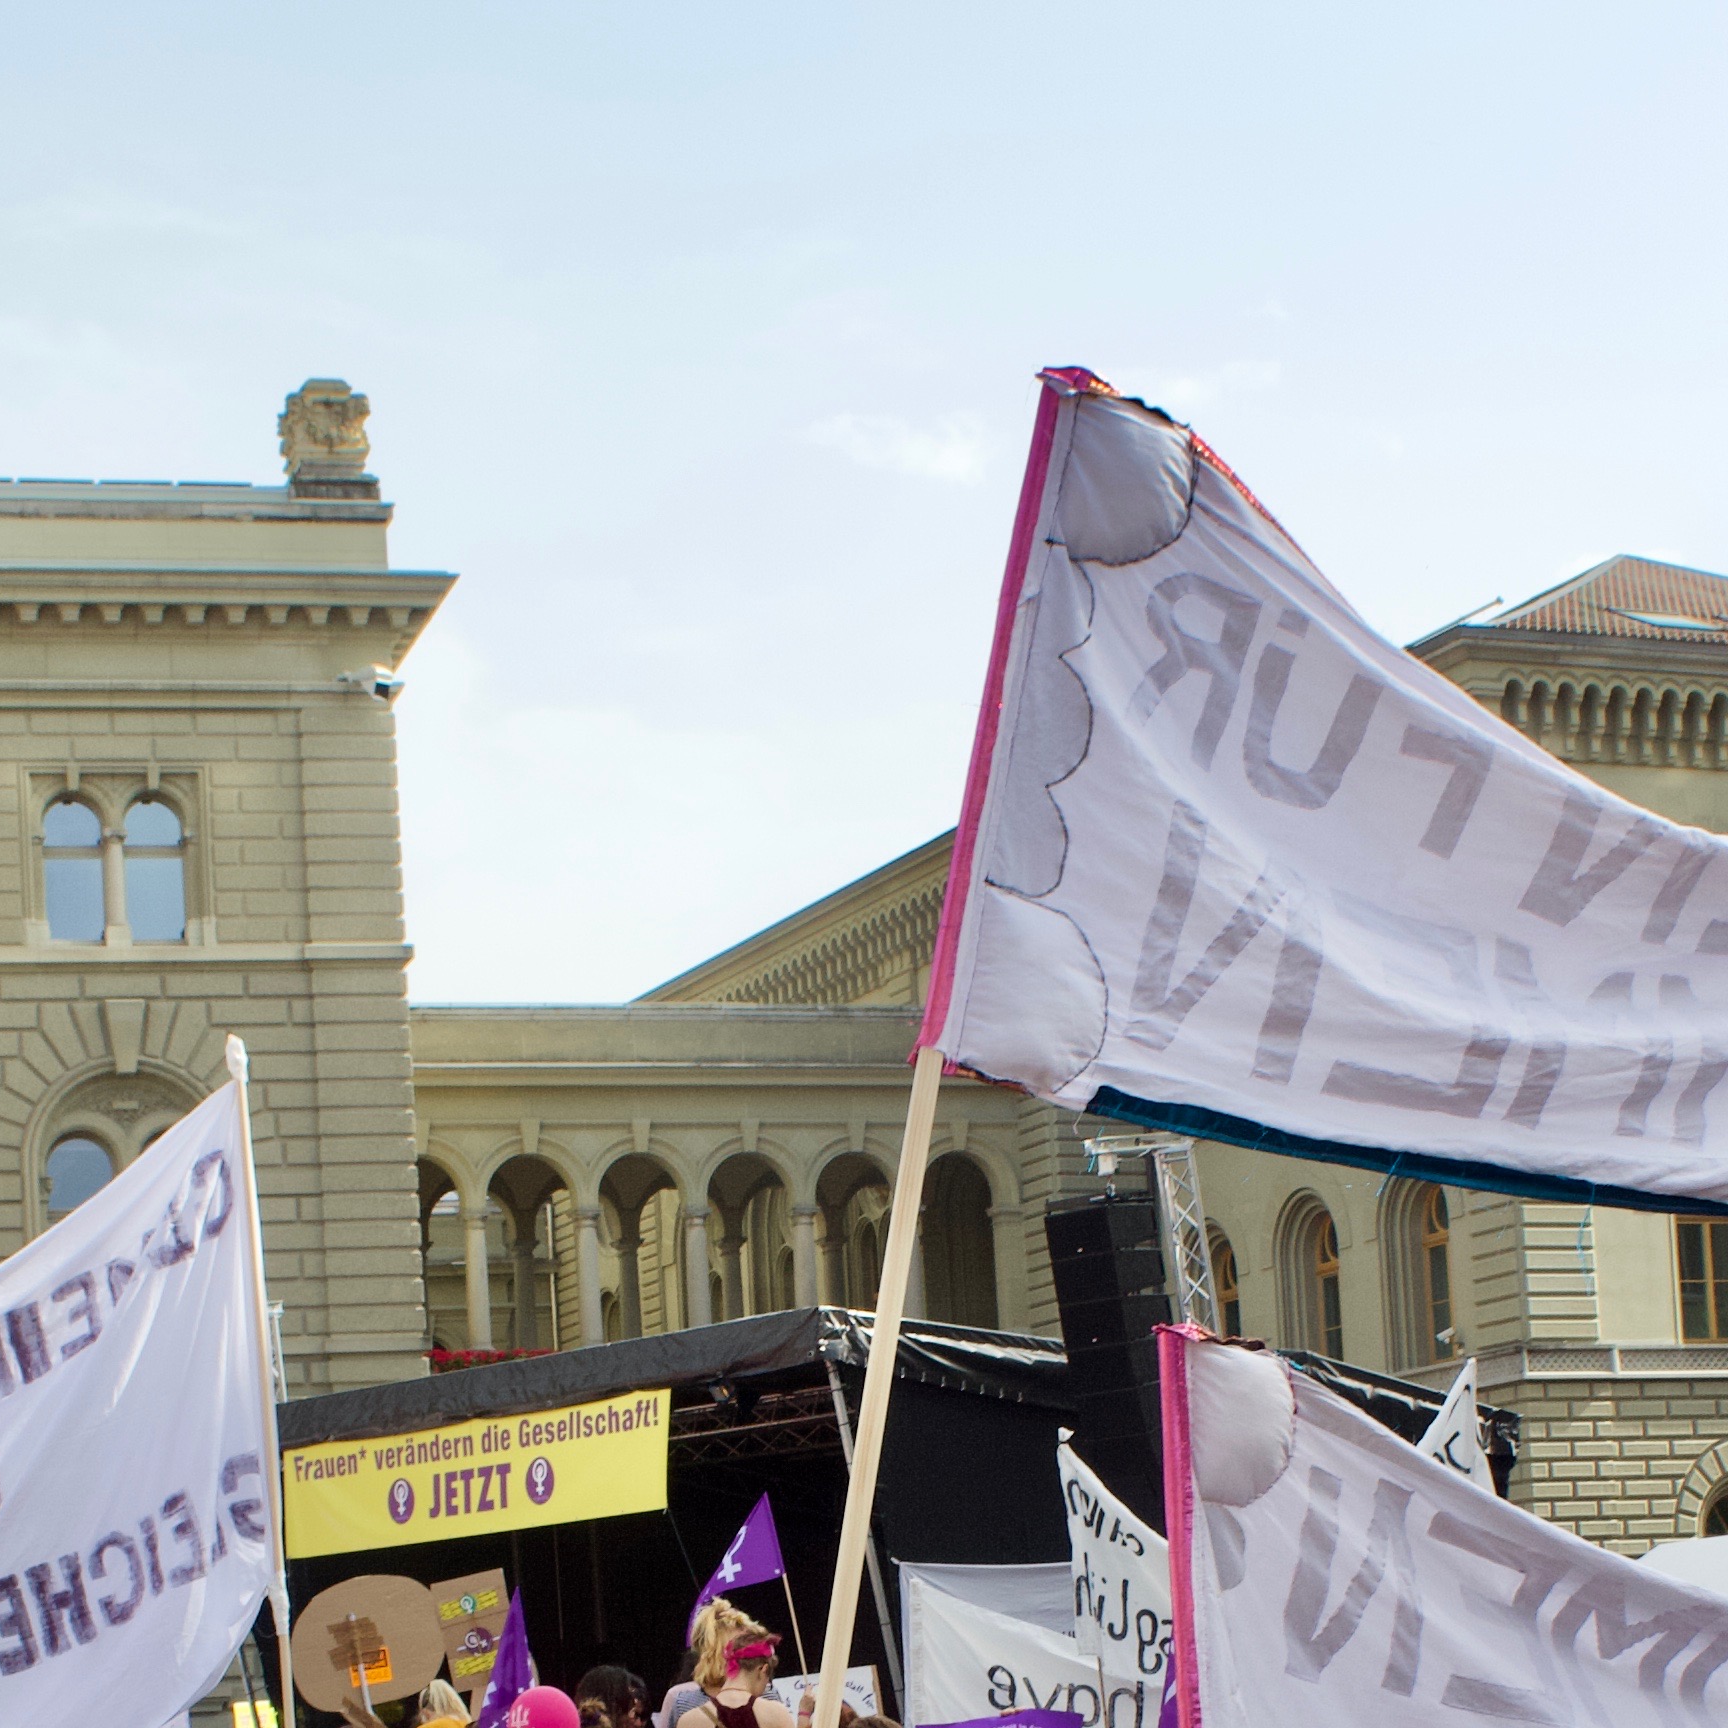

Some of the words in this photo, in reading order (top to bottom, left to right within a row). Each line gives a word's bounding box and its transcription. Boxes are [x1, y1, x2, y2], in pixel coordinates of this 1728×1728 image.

[375, 1434, 472, 1472] verändern
[482, 1425, 511, 1455] die
[519, 1397, 660, 1448] Gesellschaft!
[429, 1463, 511, 1519] JETZT
